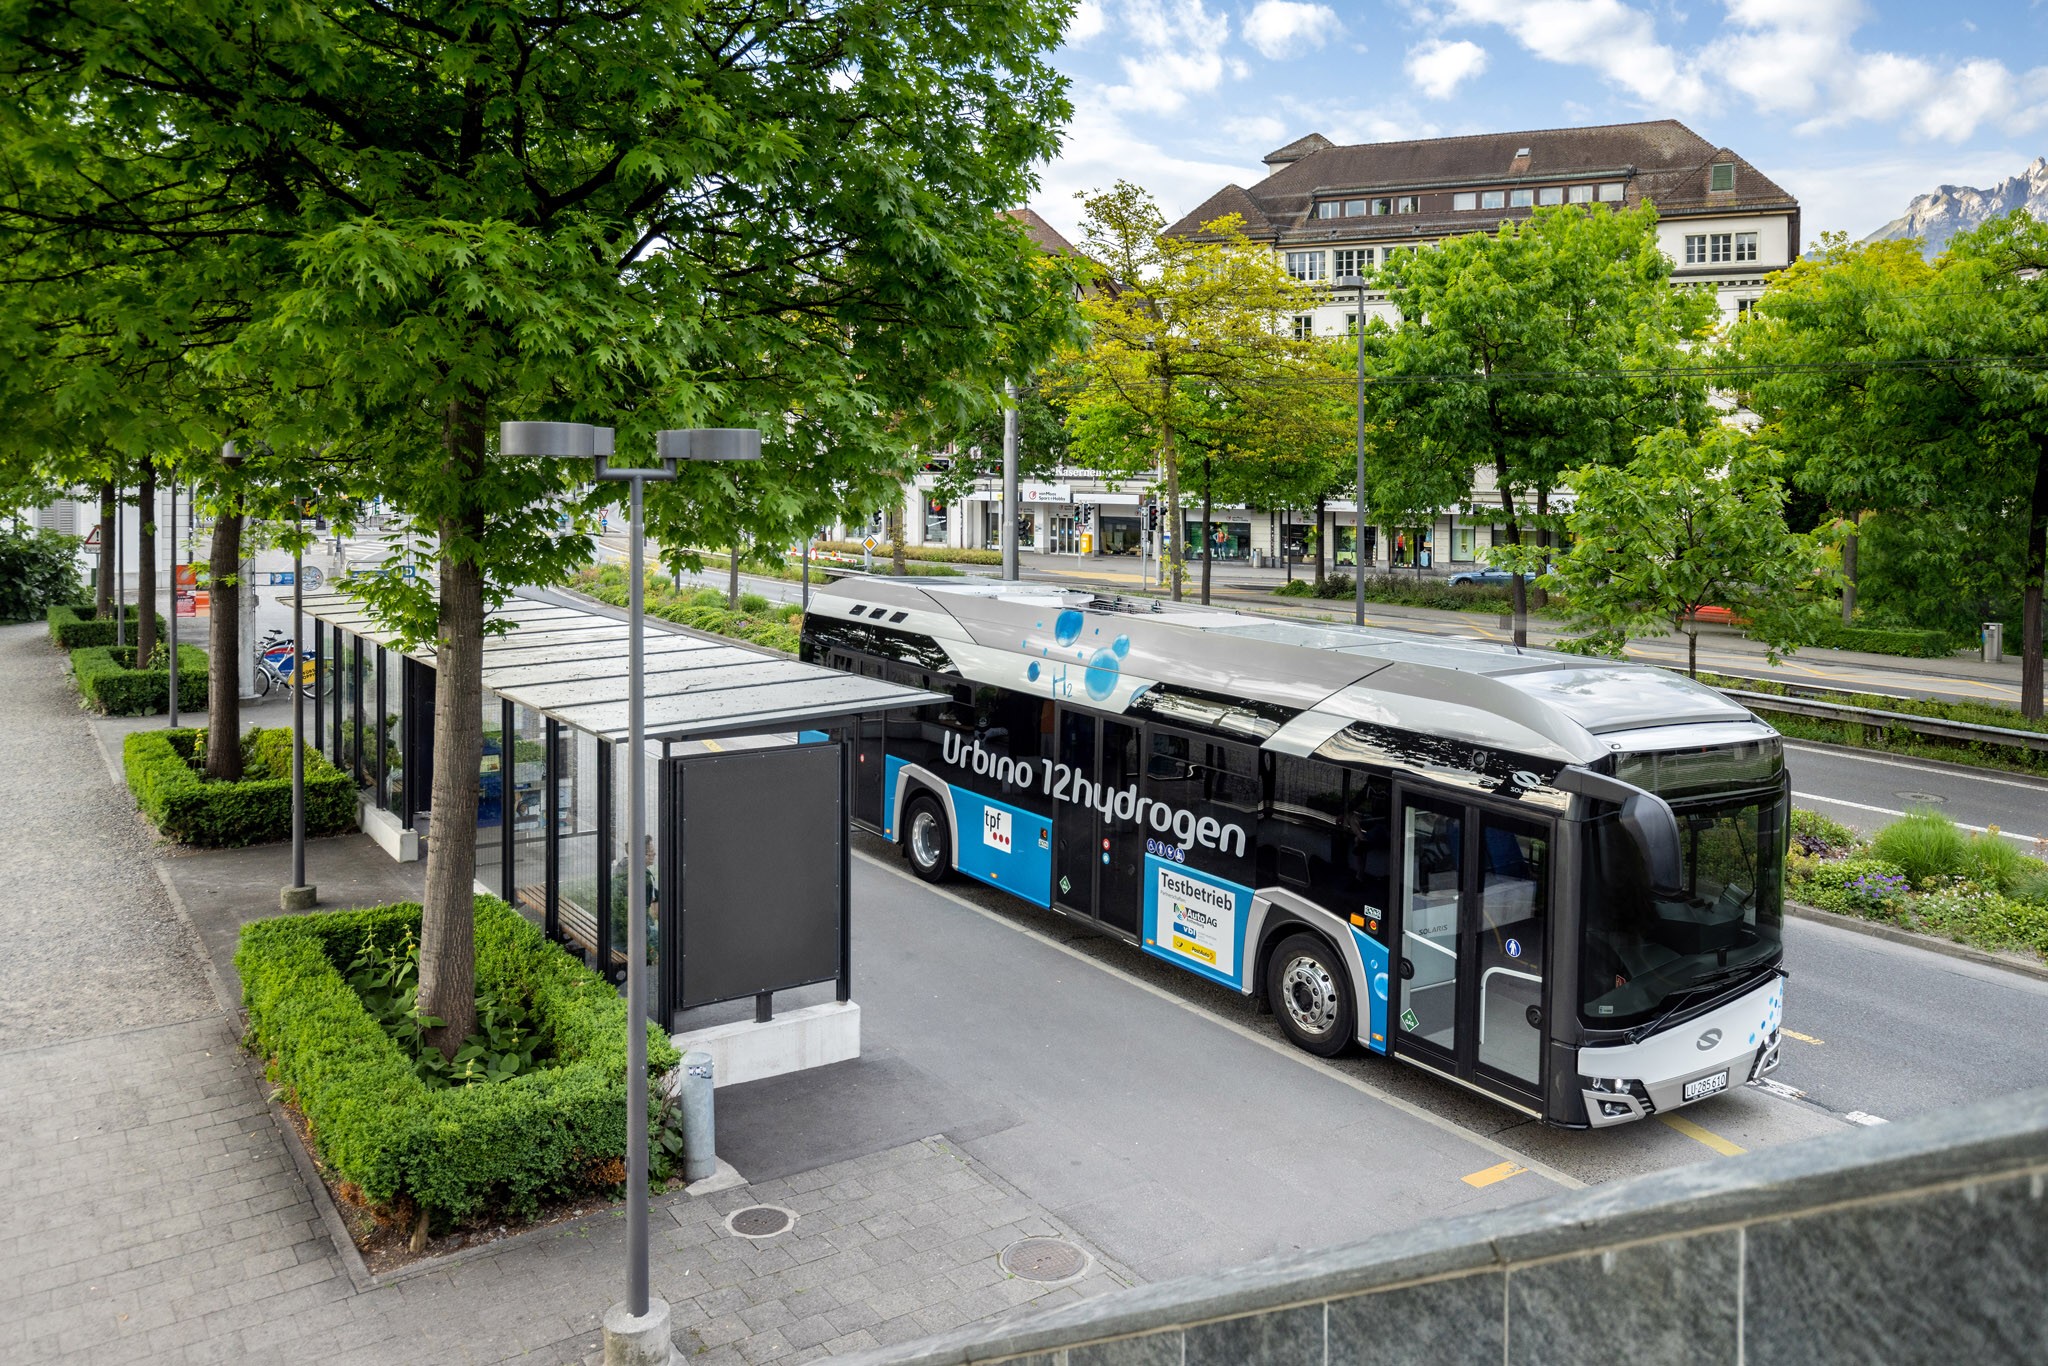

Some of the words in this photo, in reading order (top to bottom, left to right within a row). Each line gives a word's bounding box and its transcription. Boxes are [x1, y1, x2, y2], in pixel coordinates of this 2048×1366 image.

[942, 730, 1033, 788] Urbino
[984, 810, 1002, 832] tpf
[1162, 872, 1232, 911] Testbetrieb
[1186, 908, 1206, 924] Auto
[1183, 925, 1196, 936] vbl
[1418, 924, 1448, 936] SOLARIS
[1191, 946, 1210, 958] PostAuto
